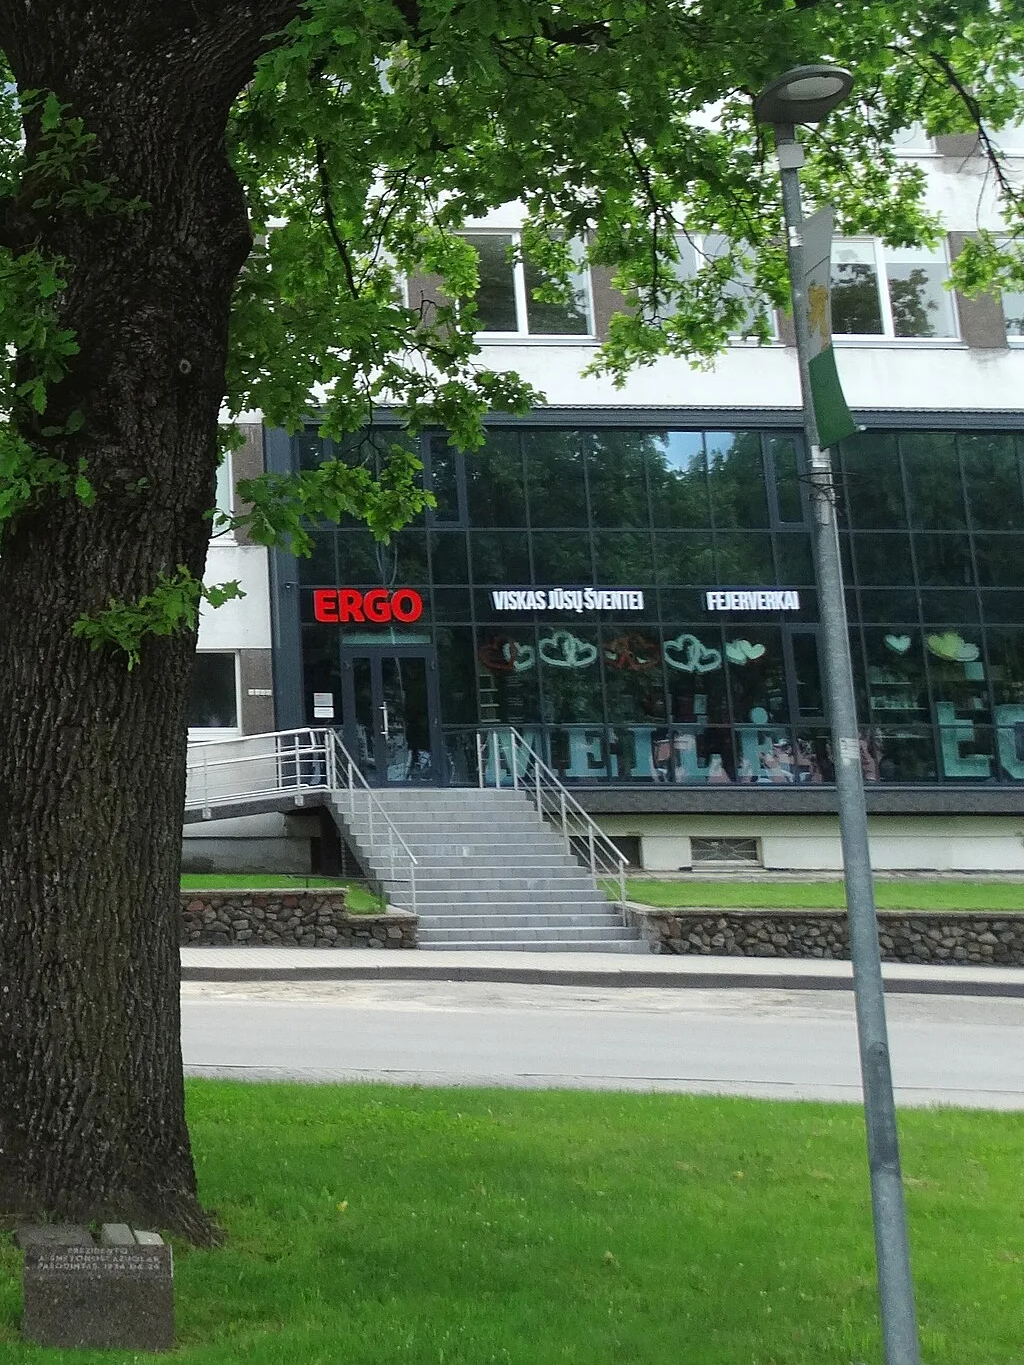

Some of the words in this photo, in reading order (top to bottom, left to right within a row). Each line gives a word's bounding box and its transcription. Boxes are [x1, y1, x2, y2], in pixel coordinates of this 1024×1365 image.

[313, 588, 423, 623] ERGO
[492, 590, 547, 610] VISKAS
[548, 587, 584, 613] JŪSŲ
[584, 587, 644, 610] ŠVENTEI
[706, 590, 800, 610] FEJERVERKAI
